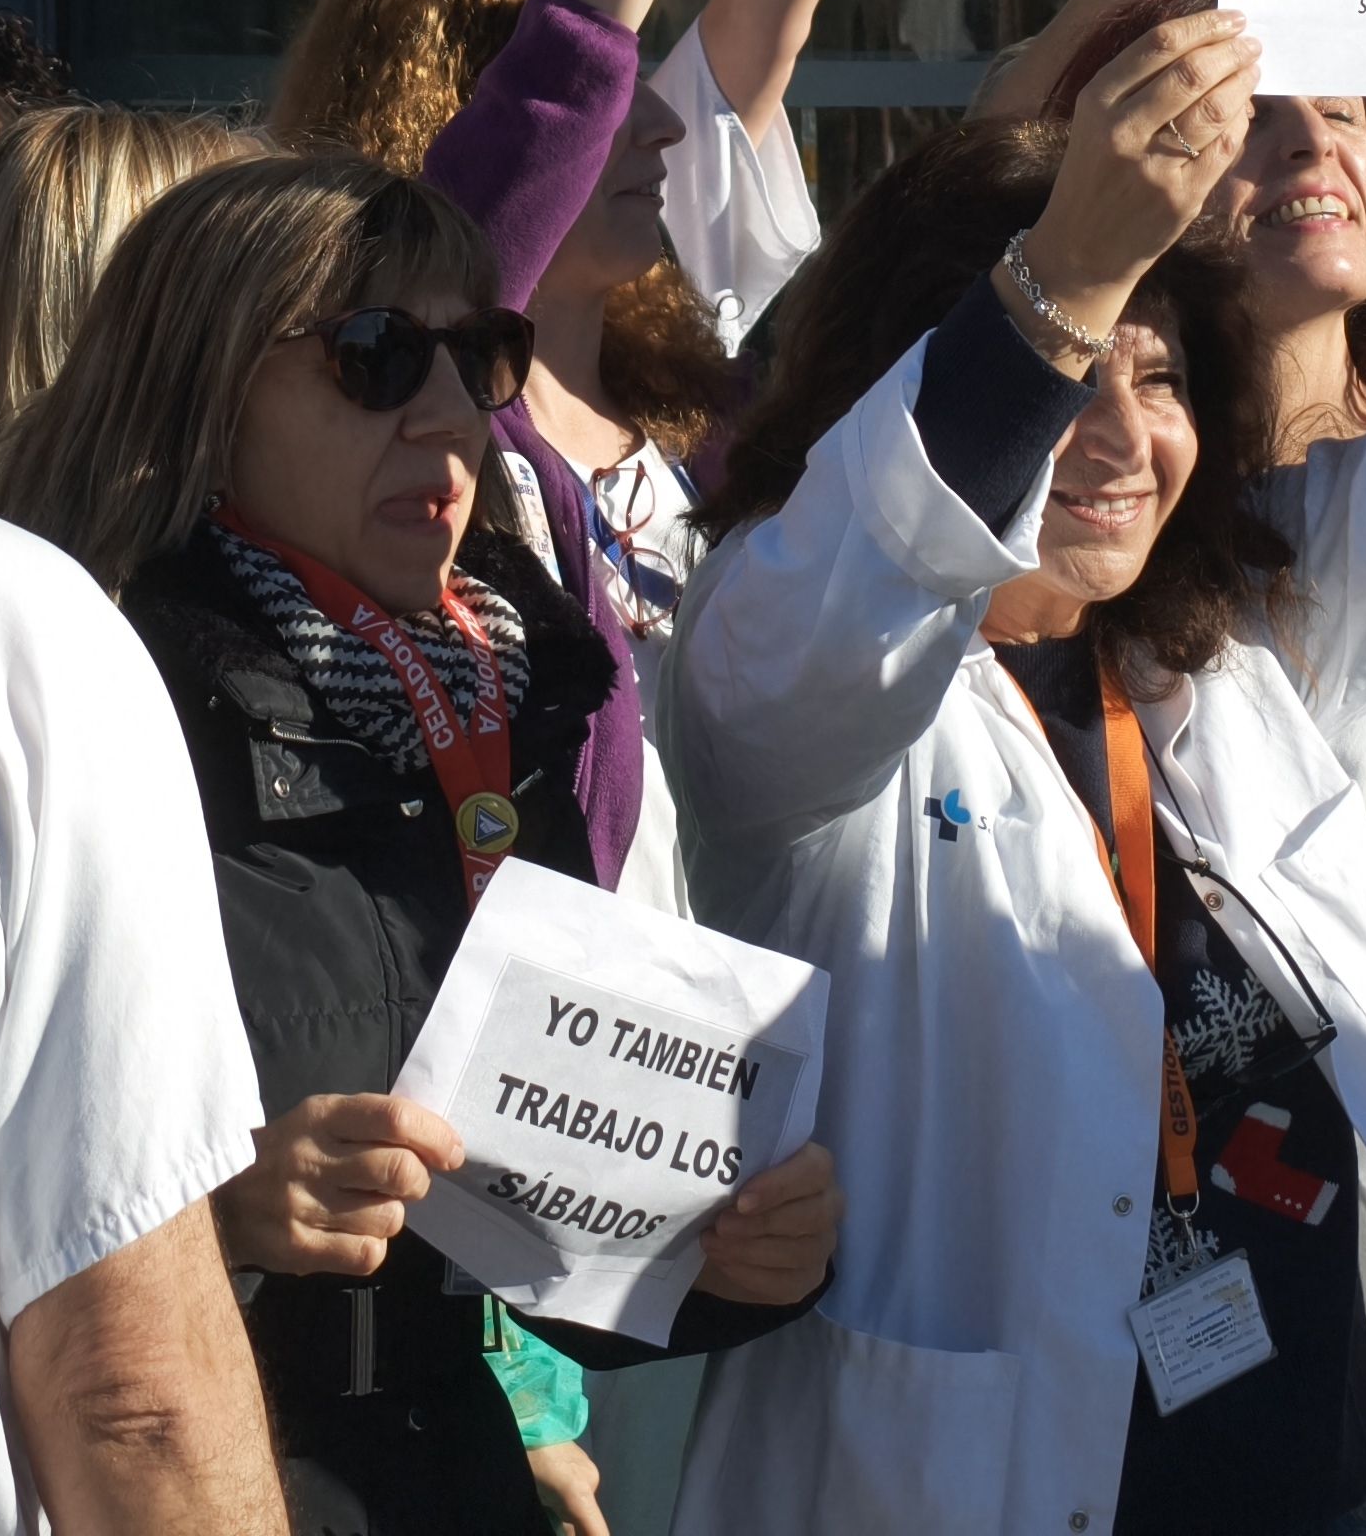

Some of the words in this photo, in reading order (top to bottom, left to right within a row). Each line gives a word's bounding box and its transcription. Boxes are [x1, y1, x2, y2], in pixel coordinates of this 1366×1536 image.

[546, 994, 598, 1046] YO
[609, 1018, 760, 1101] TAMBIÉN
[496, 1073, 663, 1160] TRABAJO
[670, 1131, 743, 1185] LOS
[487, 1172, 667, 1241] SÁBADOS
